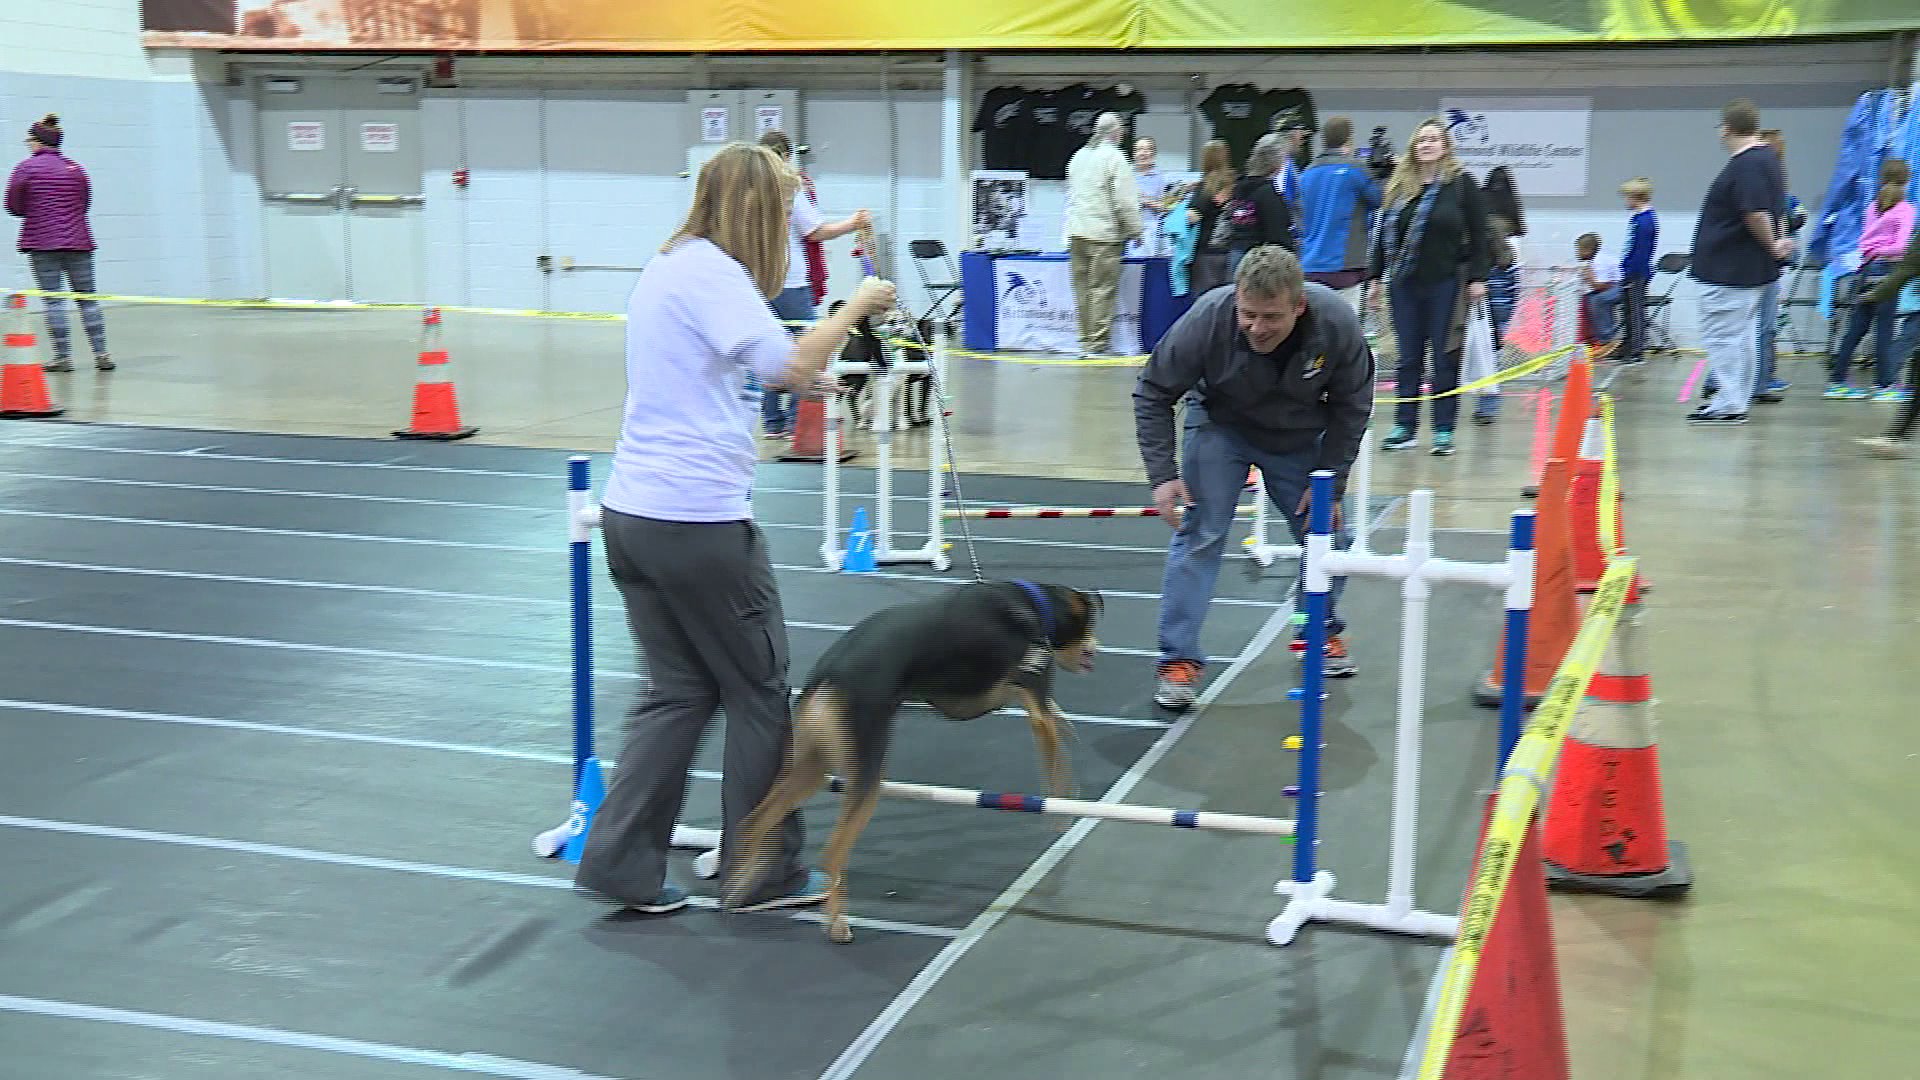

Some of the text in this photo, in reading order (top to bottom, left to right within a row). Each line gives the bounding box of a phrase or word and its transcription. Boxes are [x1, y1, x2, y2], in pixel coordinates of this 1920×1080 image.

[1498, 143, 1542, 157] Wildlife
[1543, 143, 1585, 159] Center
[851, 531, 870, 552] 7
[568, 798, 589, 837] 6
